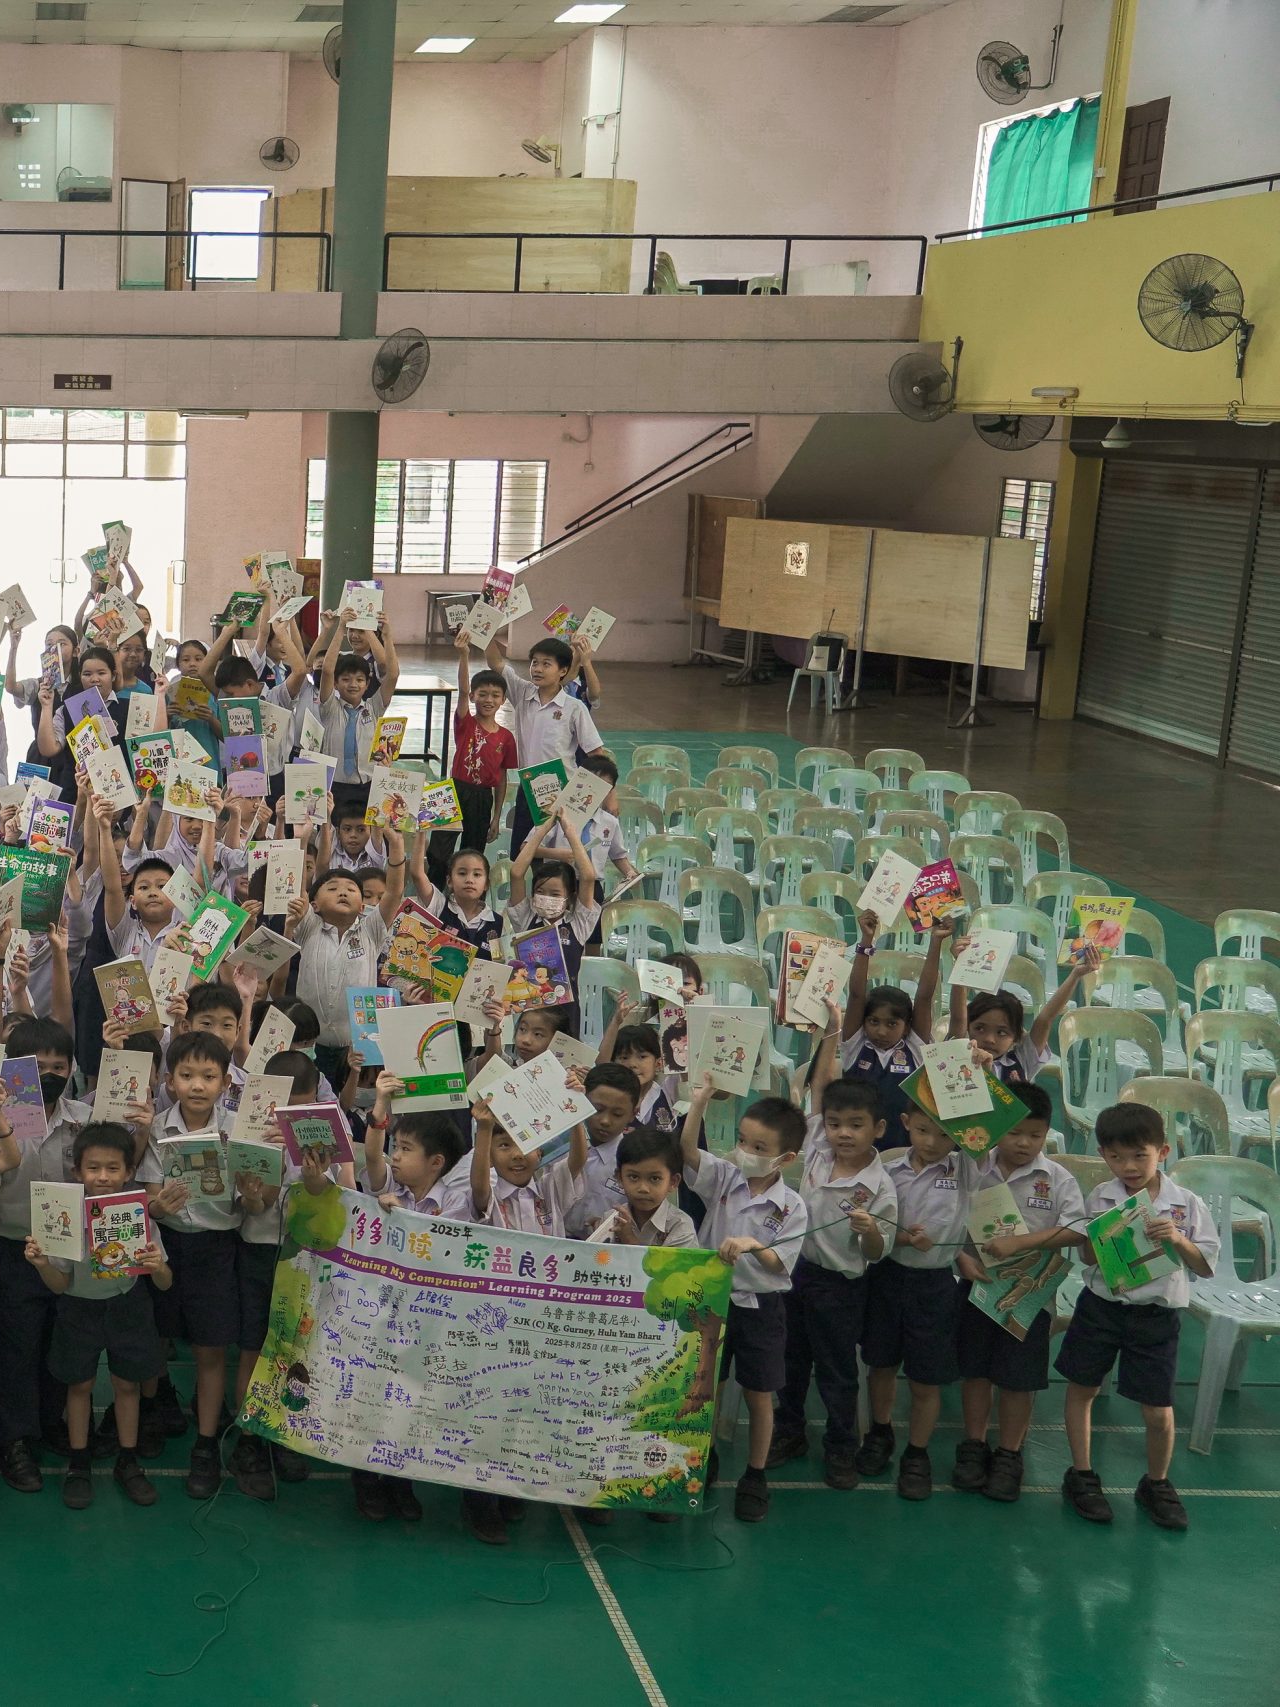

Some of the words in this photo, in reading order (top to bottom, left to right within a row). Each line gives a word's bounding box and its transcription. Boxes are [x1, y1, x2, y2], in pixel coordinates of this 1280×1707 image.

[148, 748, 164, 757] 儿童
[32, 822, 66, 838] 睡前故事
[0, 856, 58, 877] 生命的故事
[111, 1213, 132, 1225] 经典
[94, 1222, 145, 1244] 寓言故事
[431, 1223, 473, 1240] 2025年
[389, 1266, 405, 1280] My
[488, 1282, 546, 1298] Learning
[549, 1288, 603, 1302] Program
[606, 1294, 632, 1304] 2025
[572, 1269, 632, 1288] 助学计划
[513, 1316, 531, 1328] SJK
[532, 1319, 545, 1330] (C)
[547, 1322, 562, 1334] Kg.
[563, 1324, 596, 1338] Gurney,
[597, 1328, 618, 1338] Hulu
[619, 1330, 636, 1339] Yam
[638, 1331, 662, 1342] Bharu
[544, 1337, 598, 1352] 2025年8月25日
[600, 1342, 629, 1356] (星期一)
[644, 1451, 668, 1462] TOTO
